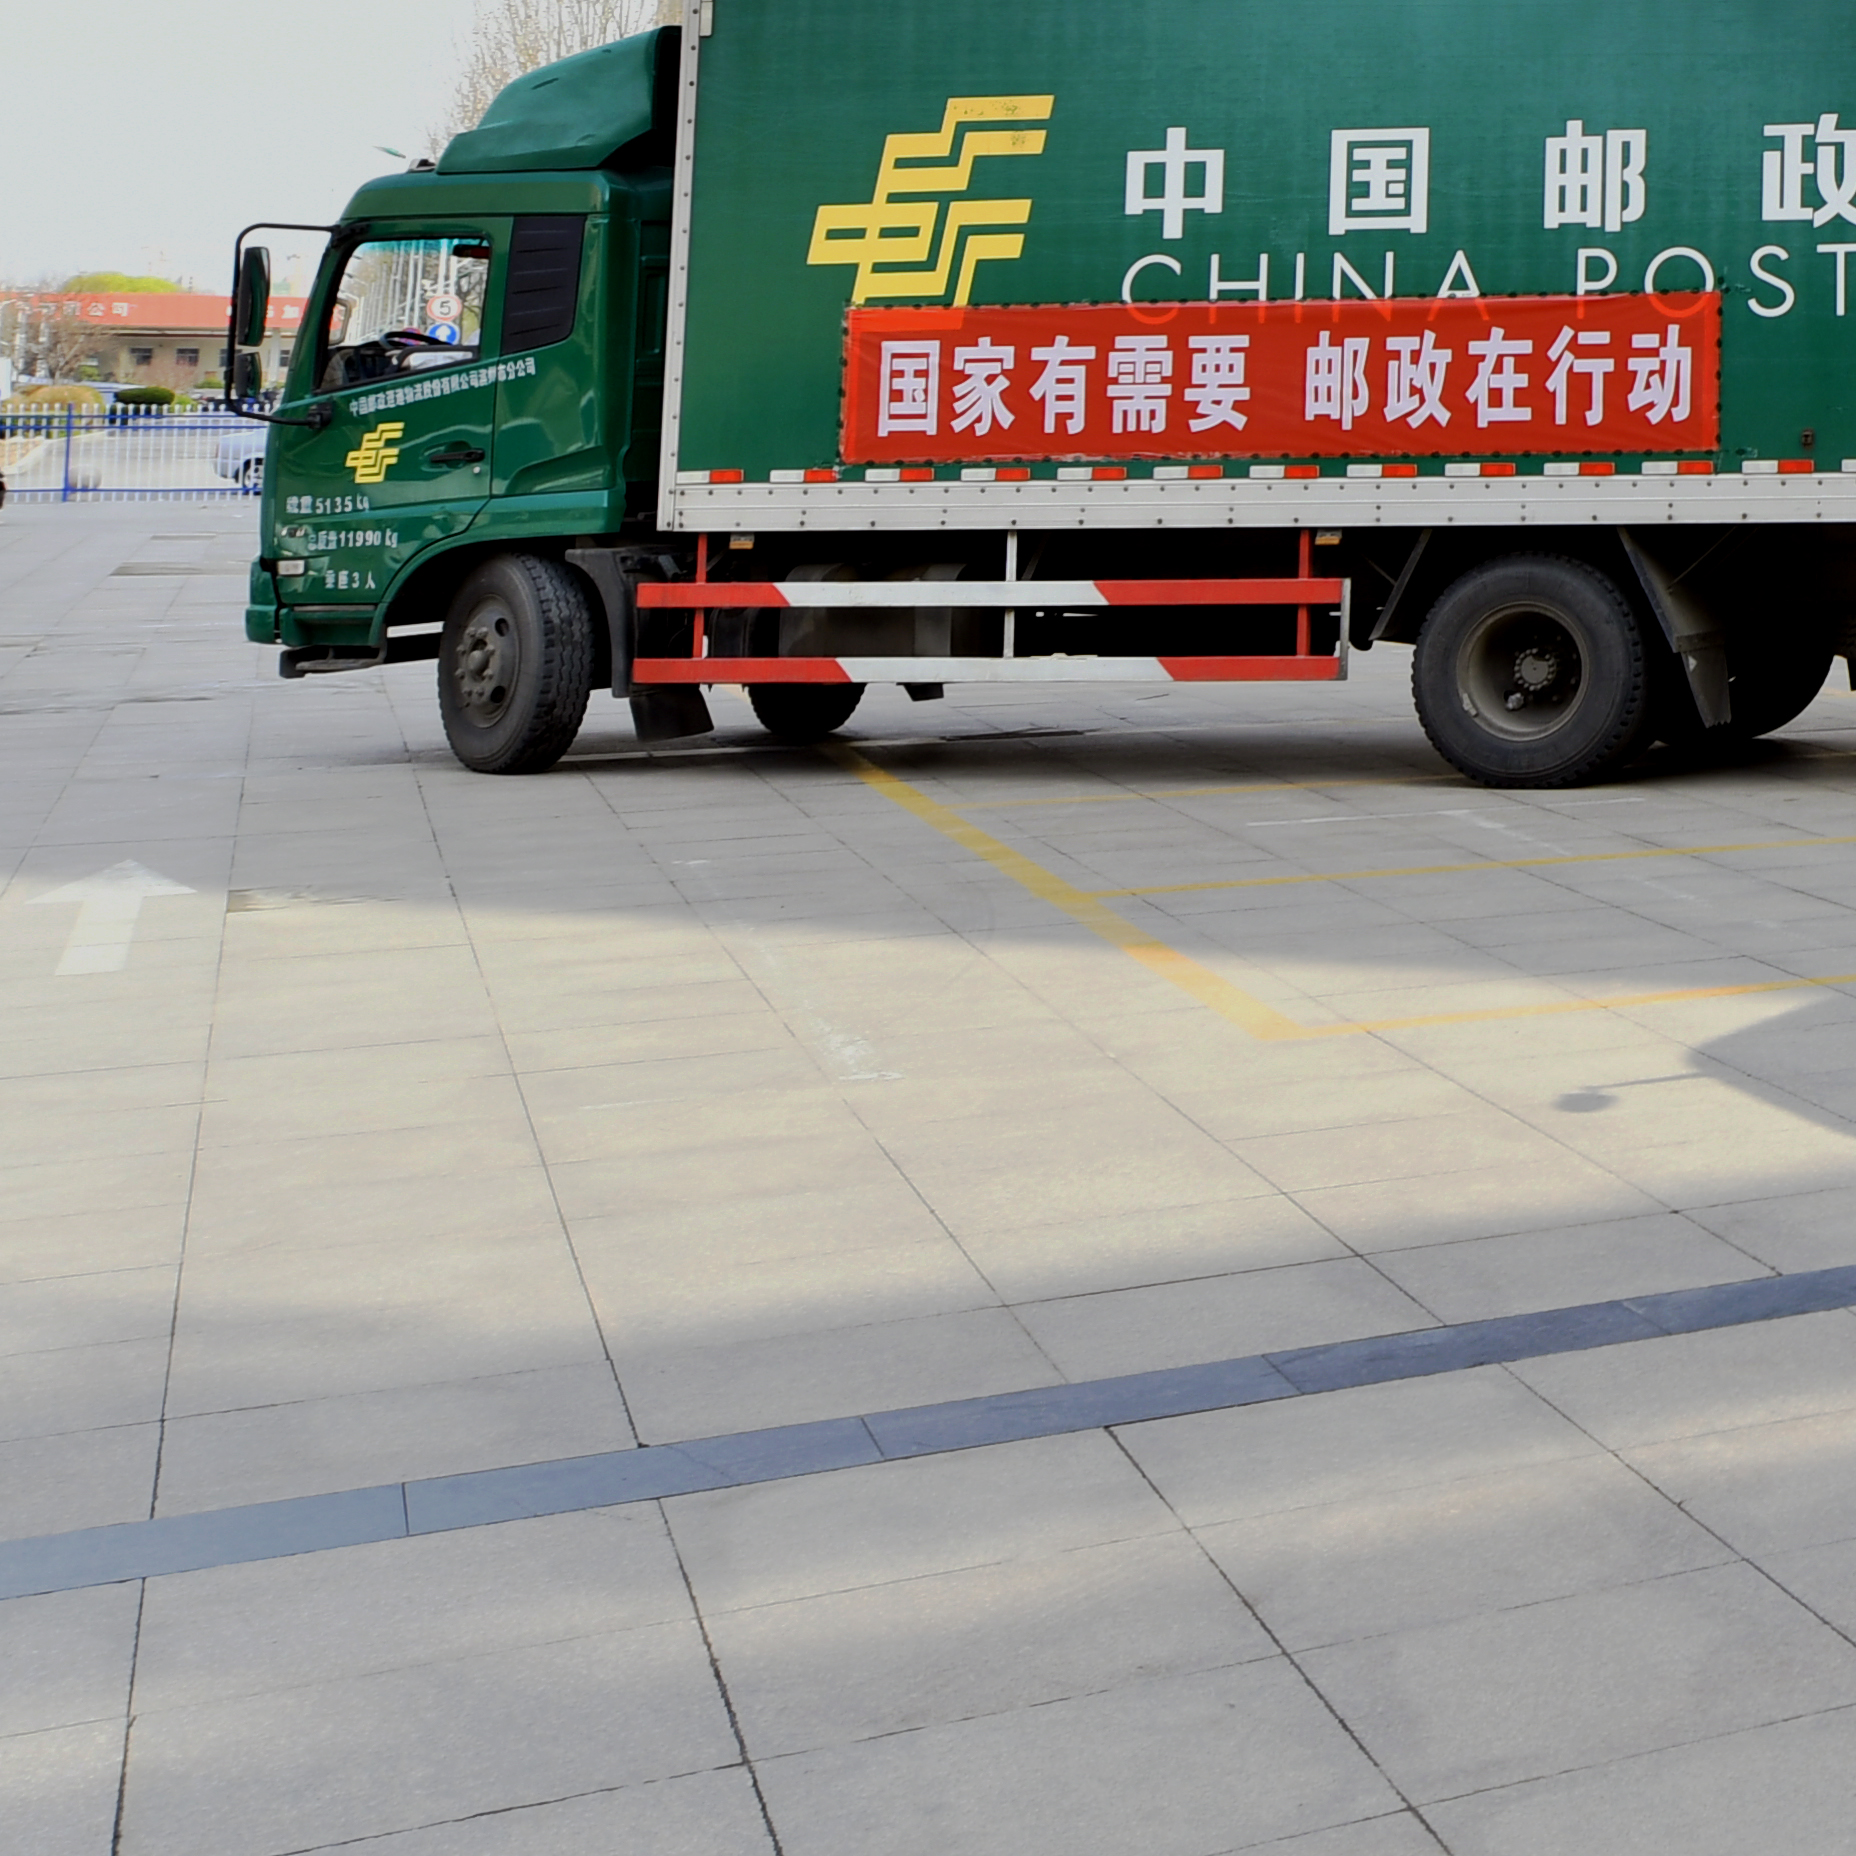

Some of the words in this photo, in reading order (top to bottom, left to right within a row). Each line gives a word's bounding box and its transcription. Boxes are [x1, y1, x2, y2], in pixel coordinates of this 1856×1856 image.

[440, 300, 451, 316] 5
[878, 334, 1250, 436] 国家有需要
[1304, 323, 1693, 430] 邮政在行动
